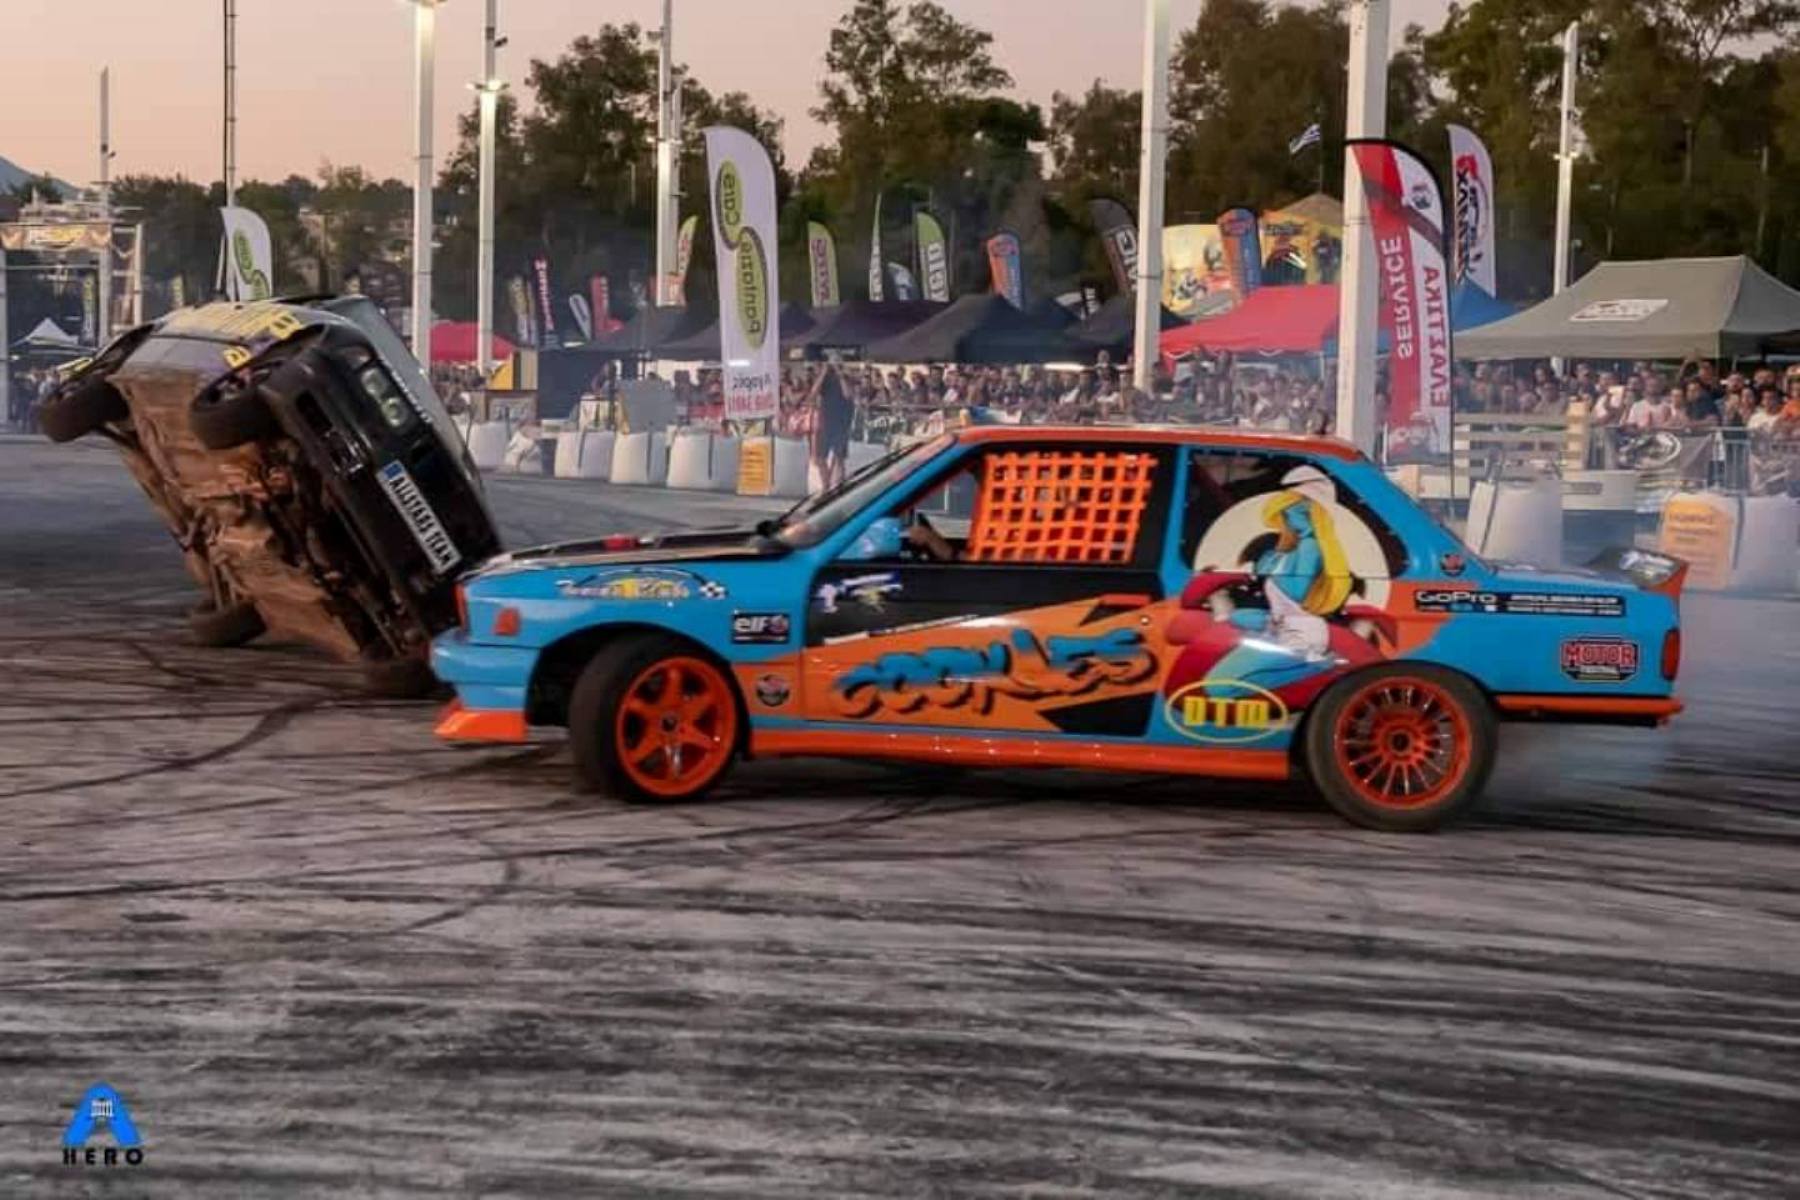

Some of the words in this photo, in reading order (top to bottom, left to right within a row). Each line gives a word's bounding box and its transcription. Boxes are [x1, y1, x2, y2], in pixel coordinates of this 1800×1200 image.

[424, 531, 452, 566] TEAM
[1416, 591, 1497, 604] GoPro
[1562, 643, 1636, 667] MOTOR
